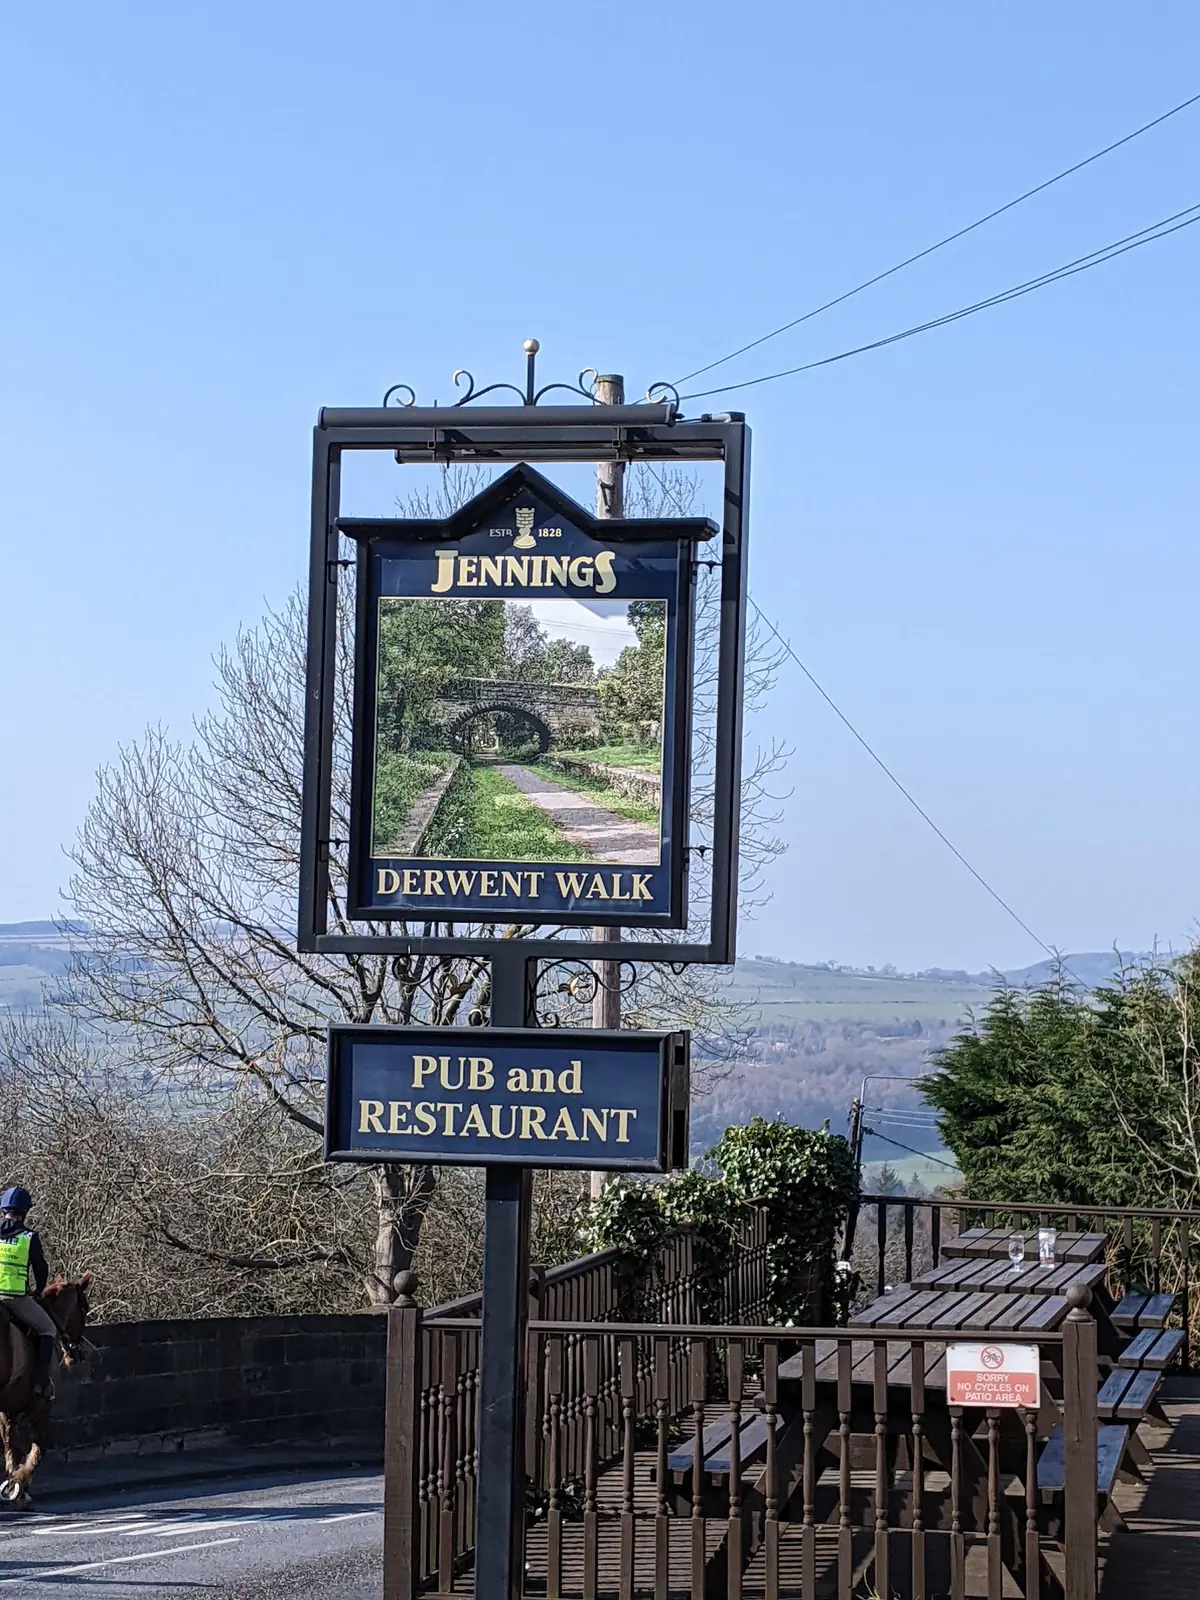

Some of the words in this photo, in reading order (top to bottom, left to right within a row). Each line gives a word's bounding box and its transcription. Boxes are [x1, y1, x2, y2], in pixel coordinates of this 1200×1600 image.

[538, 528, 562, 537] 1828
[431, 550, 617, 594] JENNINGS
[377, 868, 544, 898] DERWENT
[555, 872, 654, 900] WALK
[411, 1055, 495, 1091] PUB
[506, 1060, 583, 1094] and
[357, 1100, 637, 1143] RESTAURANT
[957, 1382, 972, 1391] NO
[974, 1383, 1012, 1392] CYCLES
[1014, 1384, 1029, 1393] ON
[976, 1373, 1010, 1382] SORRY
[965, 1392, 992, 1401] PATIO
[995, 1393, 1022, 1402] AREA
